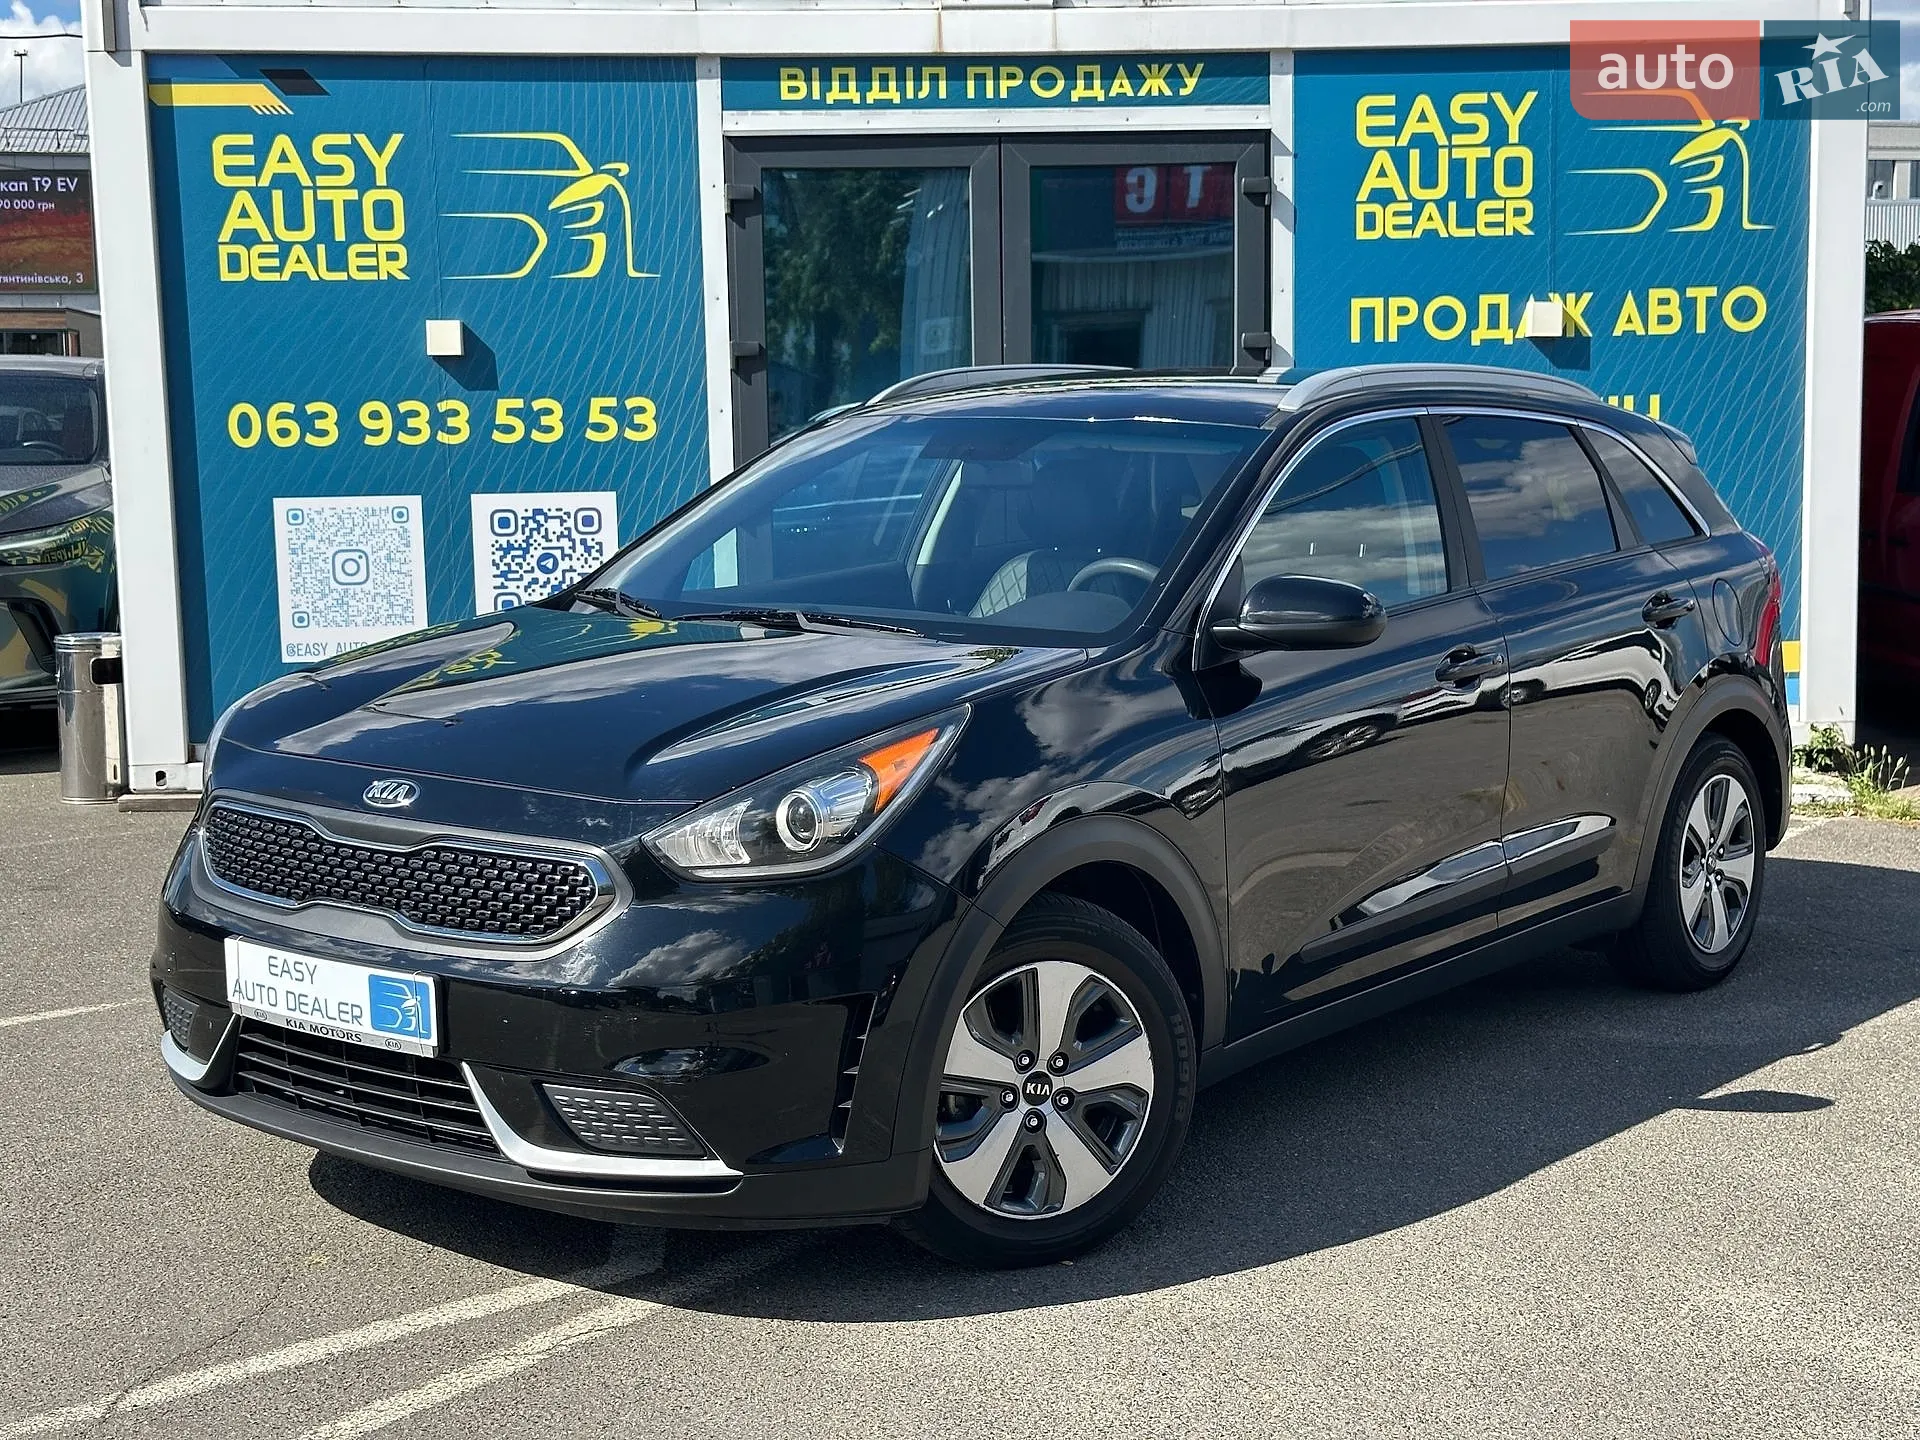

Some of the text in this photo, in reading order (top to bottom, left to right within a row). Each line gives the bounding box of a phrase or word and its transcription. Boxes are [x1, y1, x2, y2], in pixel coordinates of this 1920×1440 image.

[780, 63, 1205, 104] ВІДДІЛ ПРОДАЖУ
[1356, 91, 1539, 147] EASY
[212, 133, 404, 187] EASY
[1356, 145, 1533, 202] AUTO
[32, 177, 51, 192] T9
[57, 177, 78, 192] EV
[14, 199, 35, 209] 000
[38, 202, 55, 212] грн
[218, 189, 405, 243] AUTO
[1356, 198, 1535, 240] DEALER
[75, 272, 84, 283] 3
[218, 243, 410, 281] DEALER
[1612, 285, 1767, 336] АВТО
[227, 396, 658, 448] 063 933 53 53
[367, 781, 410, 801] KIA
[268, 955, 318, 985] EASY
[232, 977, 364, 1026] AUTO DEALER
[286, 1018, 362, 1043] KIA MOTORS
[1026, 1082, 1050, 1096] KIA
